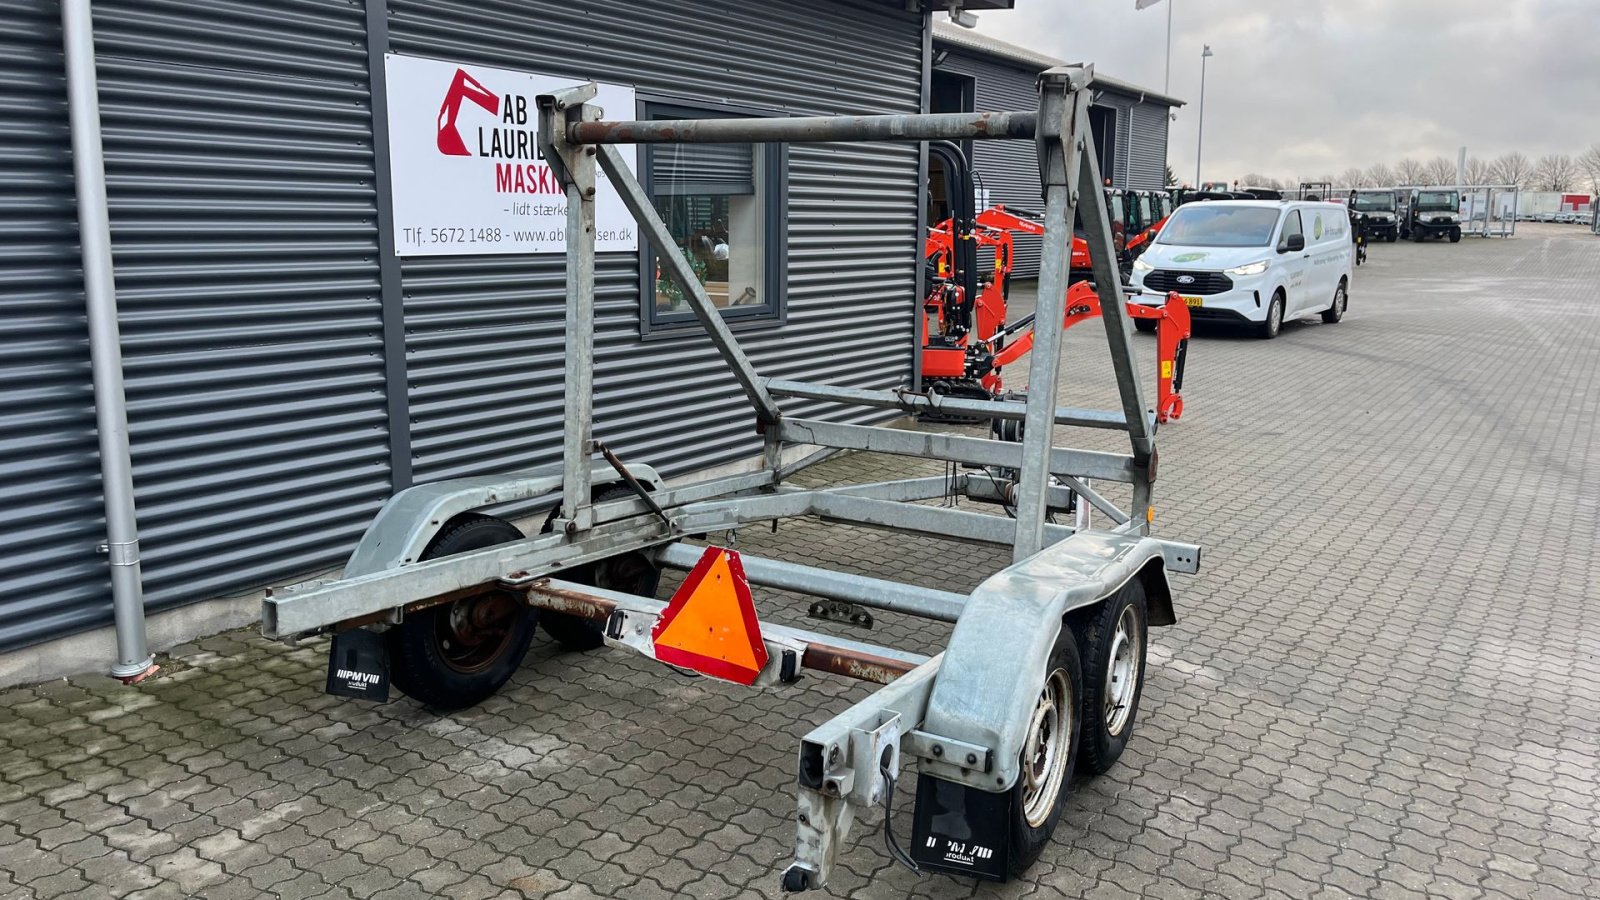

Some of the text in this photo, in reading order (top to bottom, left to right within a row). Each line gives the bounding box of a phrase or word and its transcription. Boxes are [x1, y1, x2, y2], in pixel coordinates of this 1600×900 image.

[503, 94, 528, 125] AB
[512, 202, 531, 216] lidt
[403, 227, 426, 247] Tlf.
[431, 227, 465, 243] 5672
[469, 227, 502, 243] 1488
